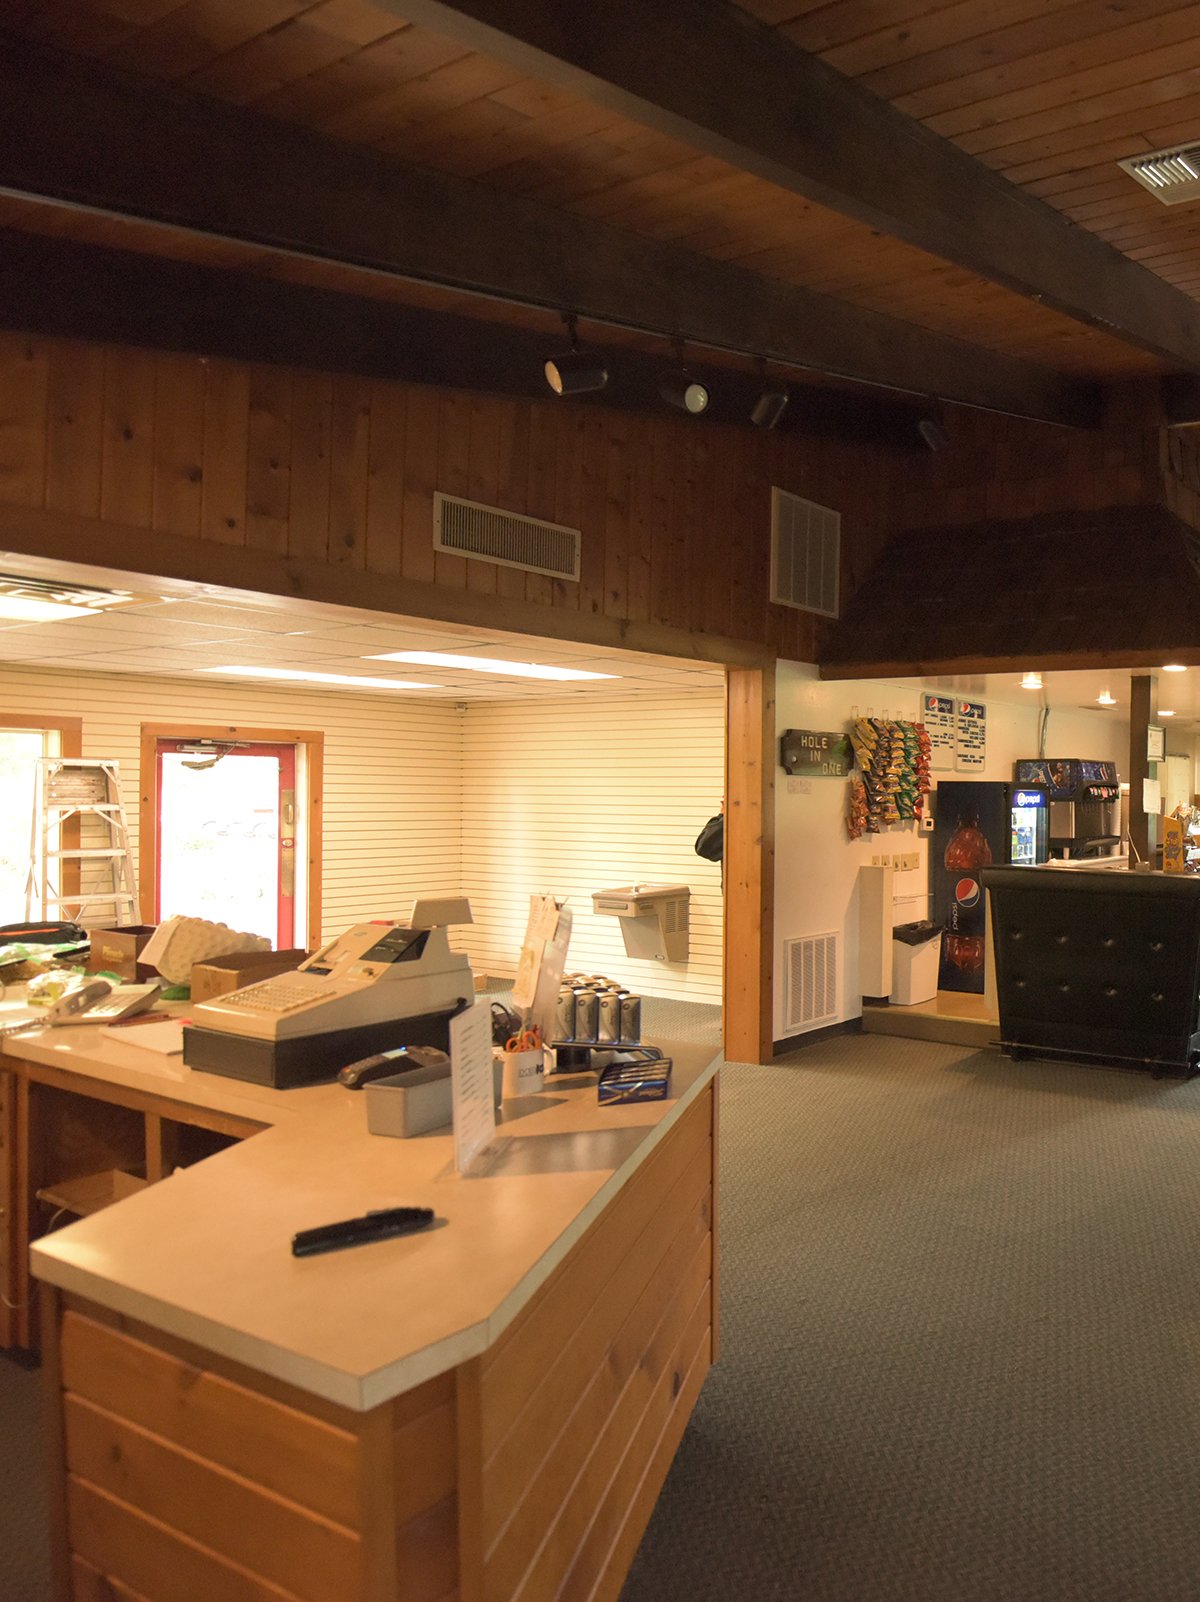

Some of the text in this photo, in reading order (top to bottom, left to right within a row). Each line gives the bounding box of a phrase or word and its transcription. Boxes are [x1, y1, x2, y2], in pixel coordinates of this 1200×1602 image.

[801, 735, 828, 749] HOLE
[810, 750, 821, 762] IN
[822, 762, 842, 775] ONE
